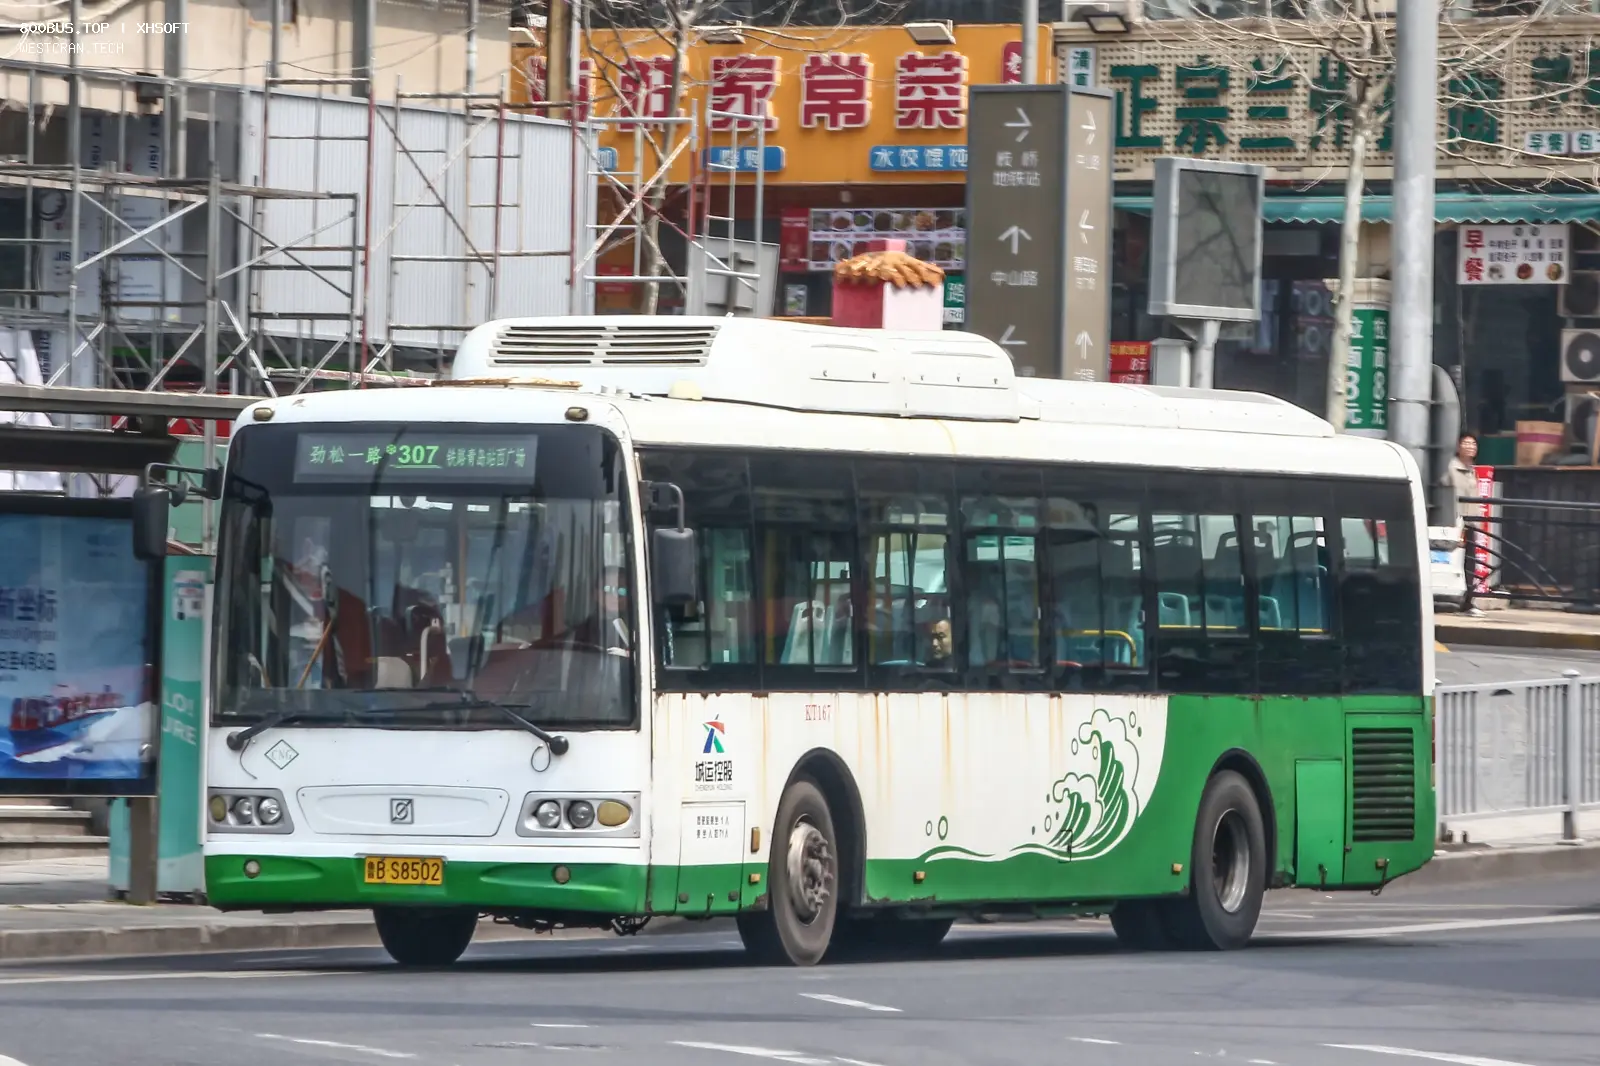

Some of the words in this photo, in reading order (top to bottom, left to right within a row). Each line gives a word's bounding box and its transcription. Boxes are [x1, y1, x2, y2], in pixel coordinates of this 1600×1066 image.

[529, 52, 969, 131] 家常菜
[993, 170, 1041, 187] 地铁站
[1464, 229, 1484, 281] 早餐
[991, 270, 1038, 287] 中山路
[309, 444, 383, 465] 劲松一路
[398, 445, 440, 464] 307
[446, 448, 526, 467] 铁路青岛站西广场
[805, 704, 831, 721] KT167
[271, 749, 292, 761] CNG
[695, 760, 733, 782] 城运控股
